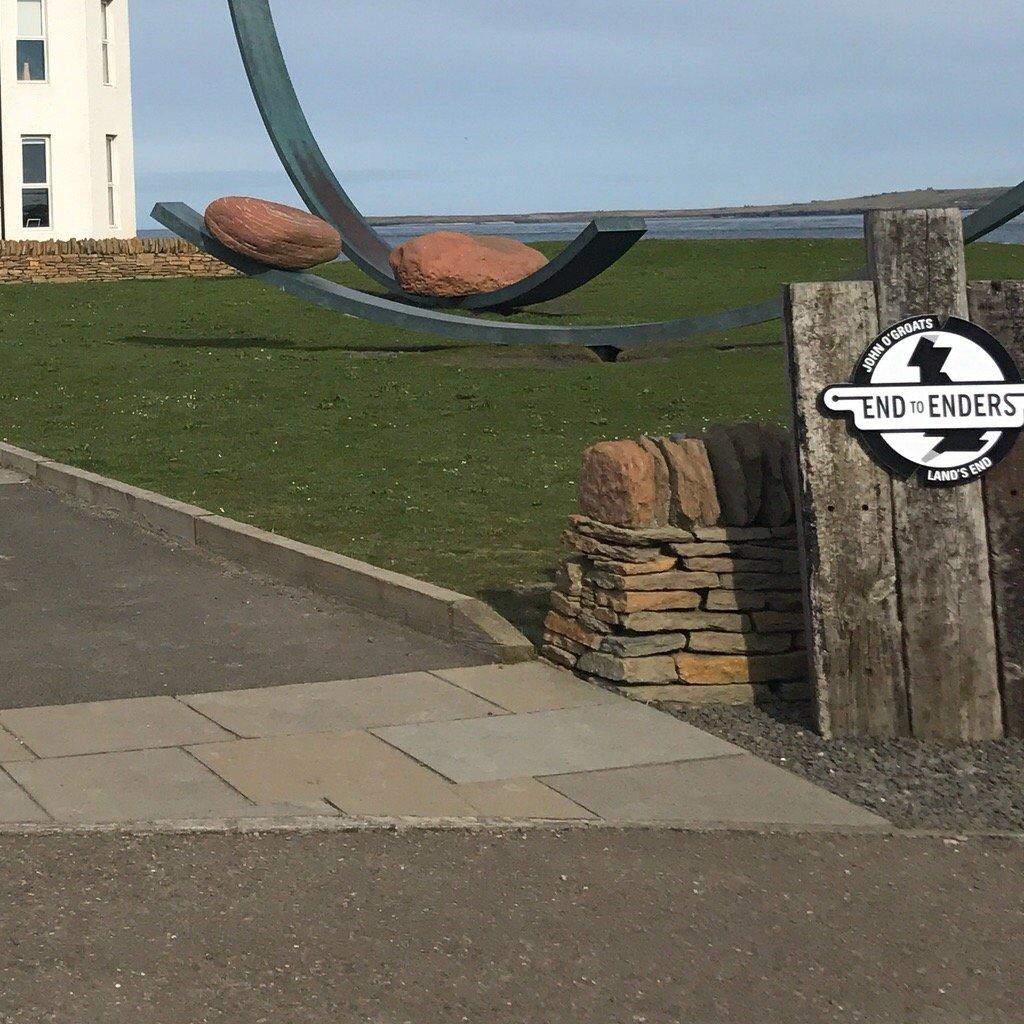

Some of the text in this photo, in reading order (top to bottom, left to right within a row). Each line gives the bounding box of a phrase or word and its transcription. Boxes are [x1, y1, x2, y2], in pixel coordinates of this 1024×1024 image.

[862, 318, 934, 373] JOHN O'GROATS
[863, 393, 1016, 419] END TO ENDERS
[927, 457, 993, 482] LAND'S END
